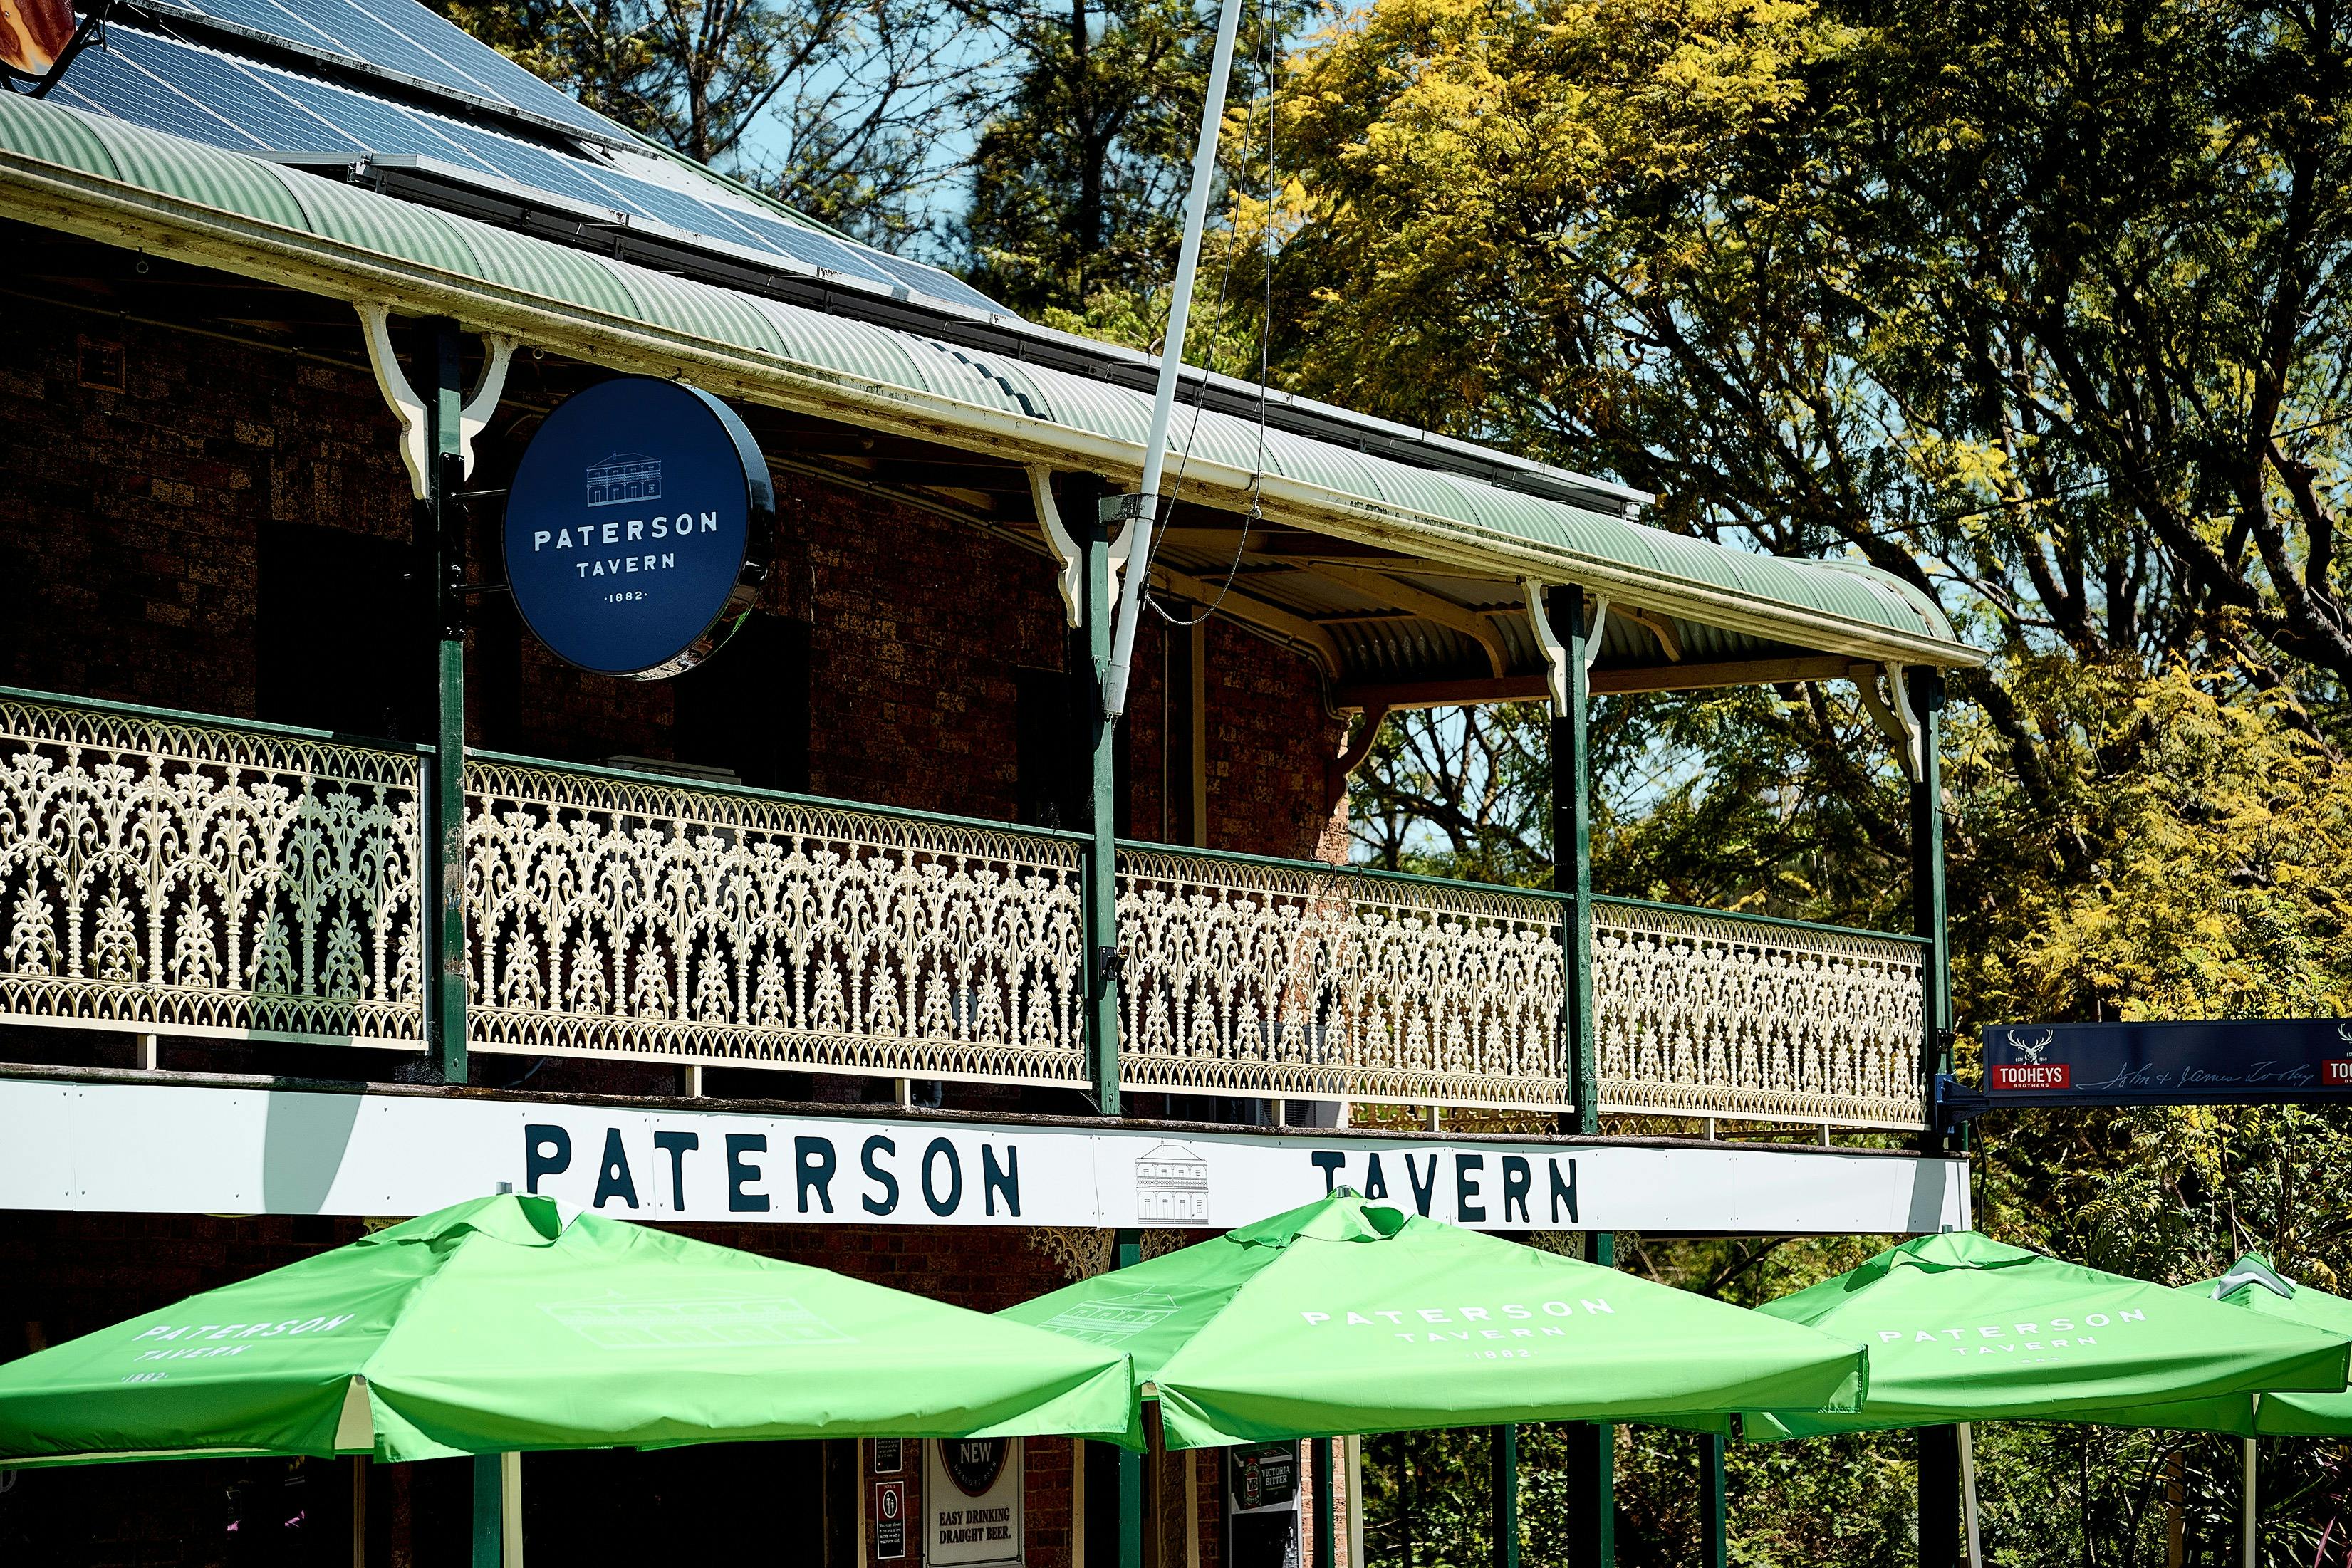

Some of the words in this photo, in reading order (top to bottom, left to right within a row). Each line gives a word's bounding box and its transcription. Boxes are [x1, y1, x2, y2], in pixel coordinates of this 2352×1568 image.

[534, 511, 717, 551] PATERSON
[576, 553, 675, 577] TAVERN
[1999, 1067, 2062, 1082] TOOHEYS
[2177, 1066, 2242, 1087] James
[525, 1124, 1021, 1217] PATERSON
[1311, 1151, 1578, 1223] TAVERN
[1300, 1298, 1615, 1326] PATERSON
[132, 1313, 355, 1342] PATERSON
[1394, 1327, 1567, 1343] TAVERN
[1877, 1308, 2148, 1344] PATERSON
[134, 1344, 252, 1361] TAVERN
[1952, 1337, 2097, 1357] TAVERN
[960, 1442, 992, 1464] NEW
[1261, 1465, 1290, 1477] VICTORIA
[1266, 1475, 1287, 1486] BITTER
[1249, 1479, 1258, 1490] VB
[939, 1511, 963, 1527] EASY
[966, 1507, 1010, 1525] DRINKING
[939, 1527, 984, 1545] DRAUGHT
[986, 1525, 1011, 1540] BEER.
